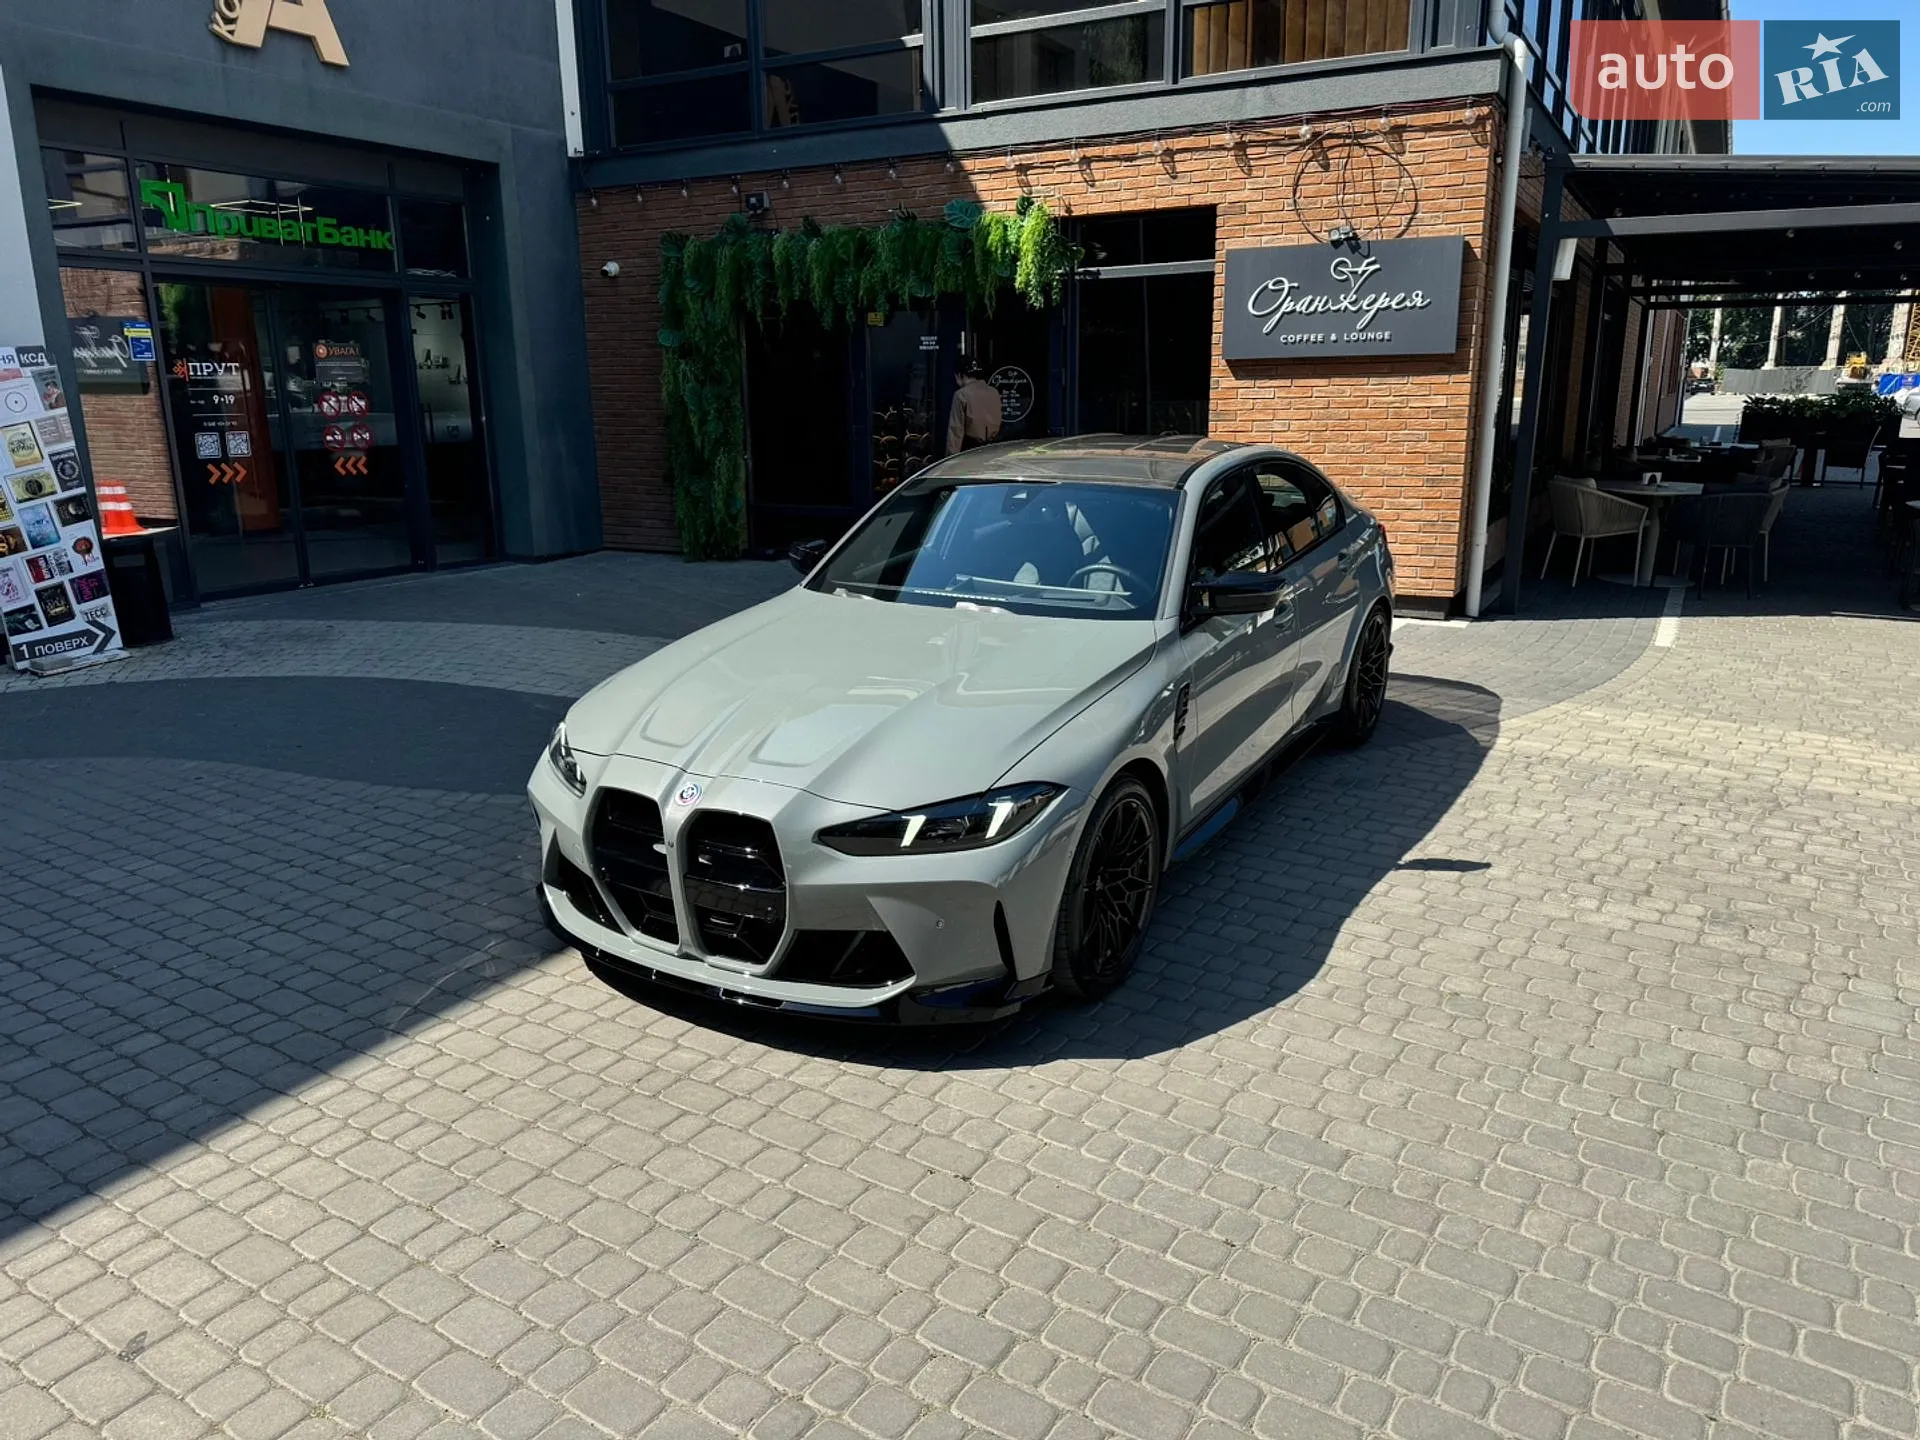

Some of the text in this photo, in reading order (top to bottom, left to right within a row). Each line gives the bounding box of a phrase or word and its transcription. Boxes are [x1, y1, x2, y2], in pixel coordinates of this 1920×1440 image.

[1247, 257, 1431, 334] Оранжерея
[1280, 331, 1392, 343] COFFEE & LOUNGE
[187, 362, 240, 376] ПРУТ
[19, 637, 90, 659] 1 ПОВЕРХ
